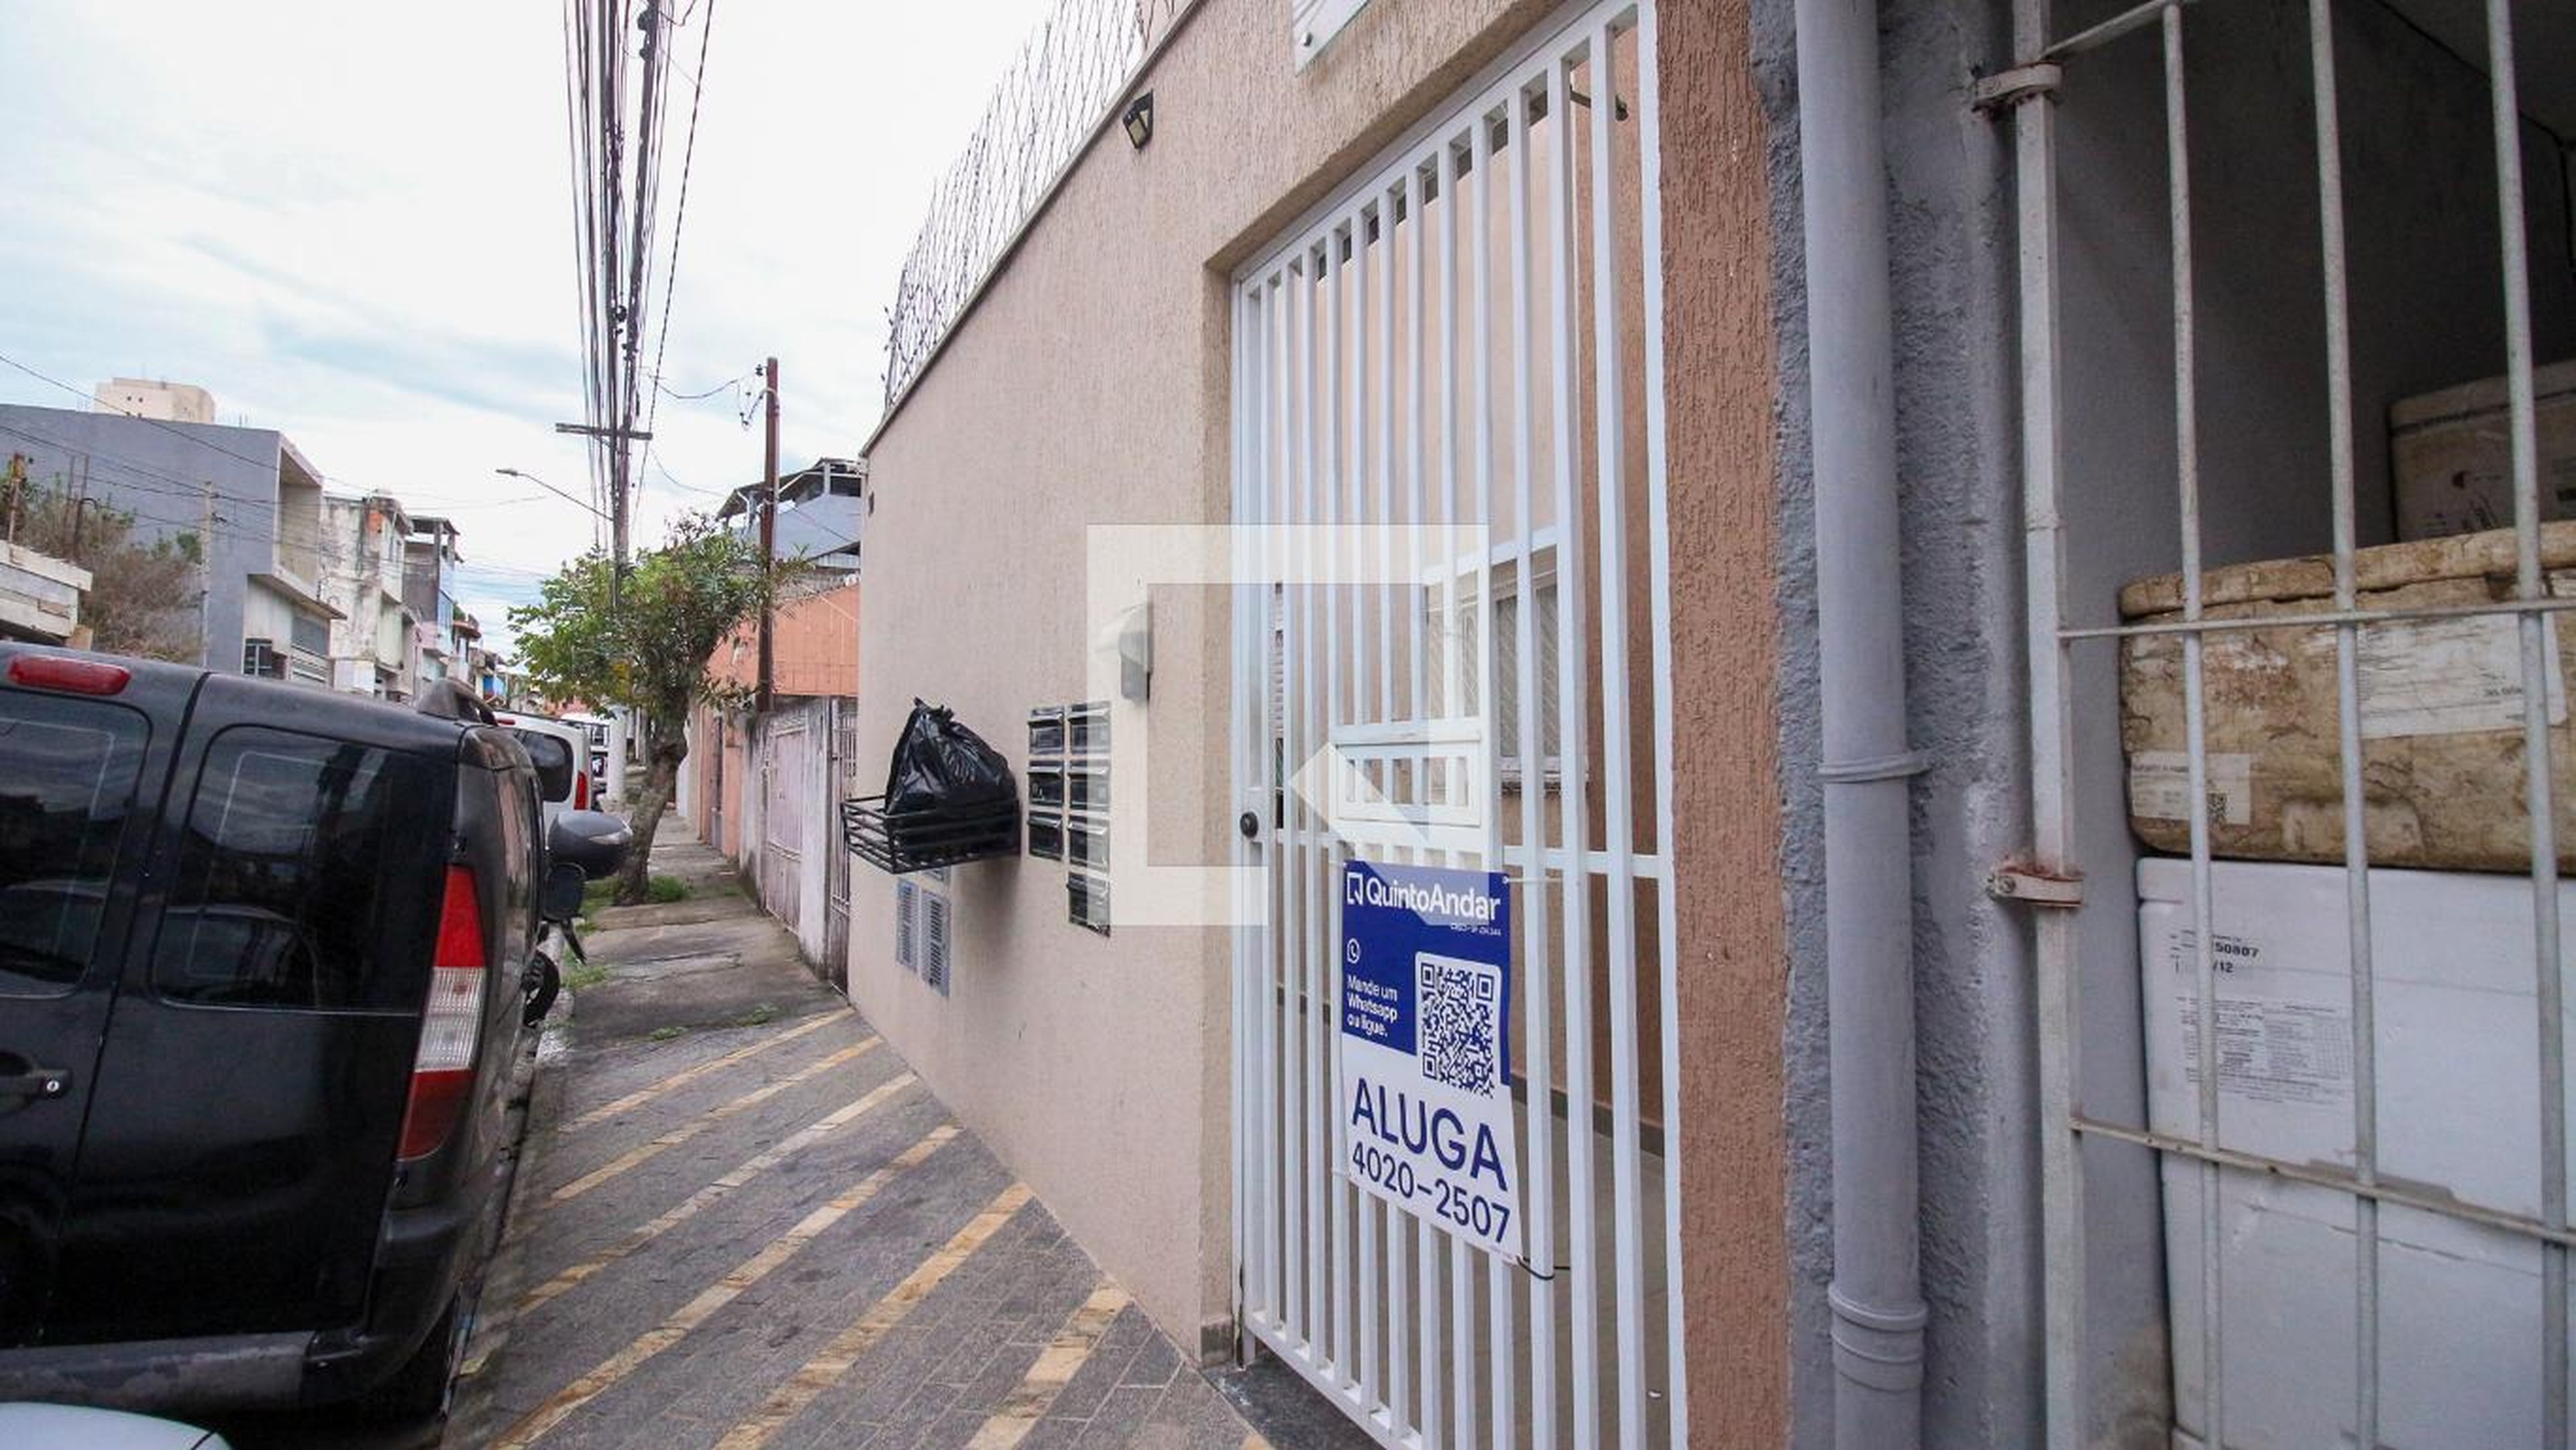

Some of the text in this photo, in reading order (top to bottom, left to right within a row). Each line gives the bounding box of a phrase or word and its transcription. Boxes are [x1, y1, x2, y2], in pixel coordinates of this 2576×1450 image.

[1366, 878, 1501, 920] QuintoAndar
[2212, 941, 2259, 957] 50807
[1347, 974, 1397, 1002] Mande um
[1347, 992, 1397, 1023] Whatsapp
[1347, 1014, 1388, 1038] ou ligue.
[1352, 1078, 1507, 1192] ALUGA
[1352, 1141, 1510, 1243] 4020-2507
